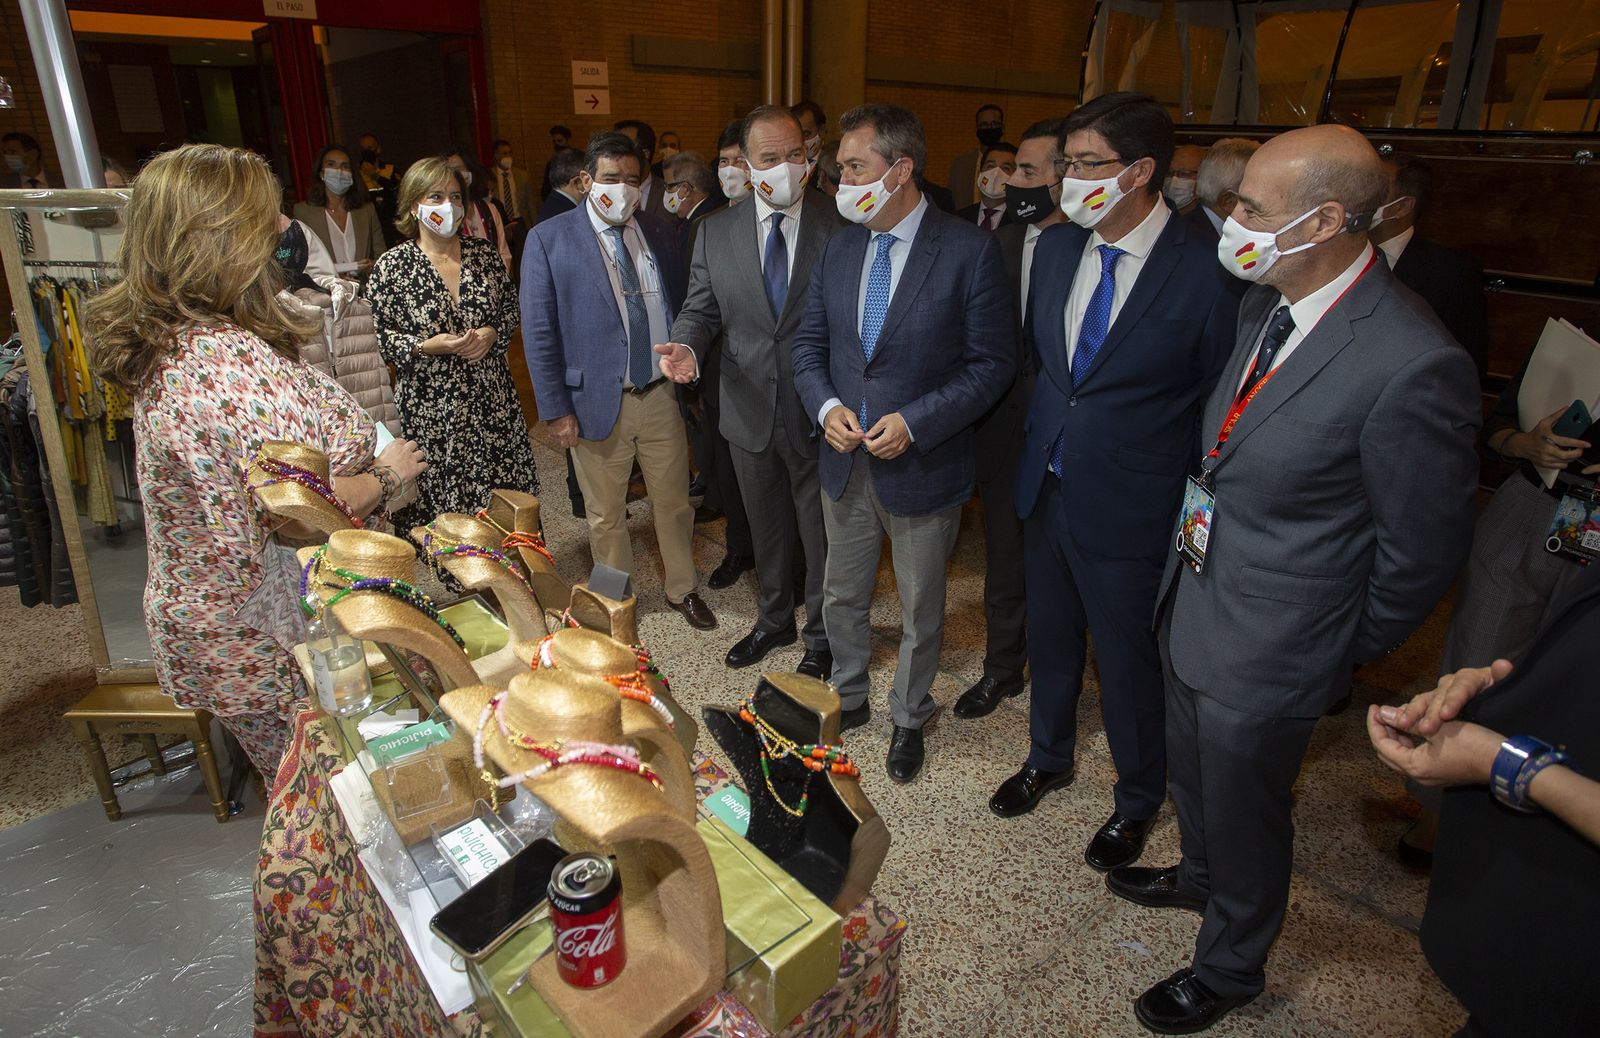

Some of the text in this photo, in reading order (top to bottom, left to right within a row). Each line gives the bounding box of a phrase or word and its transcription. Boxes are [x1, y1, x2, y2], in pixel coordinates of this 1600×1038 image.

[276, 1, 304, 12] EL PASO
[580, 66, 600, 76] SALIDA
[554, 898, 581, 913] AZÚCAR
[557, 909, 617, 958] Cola
